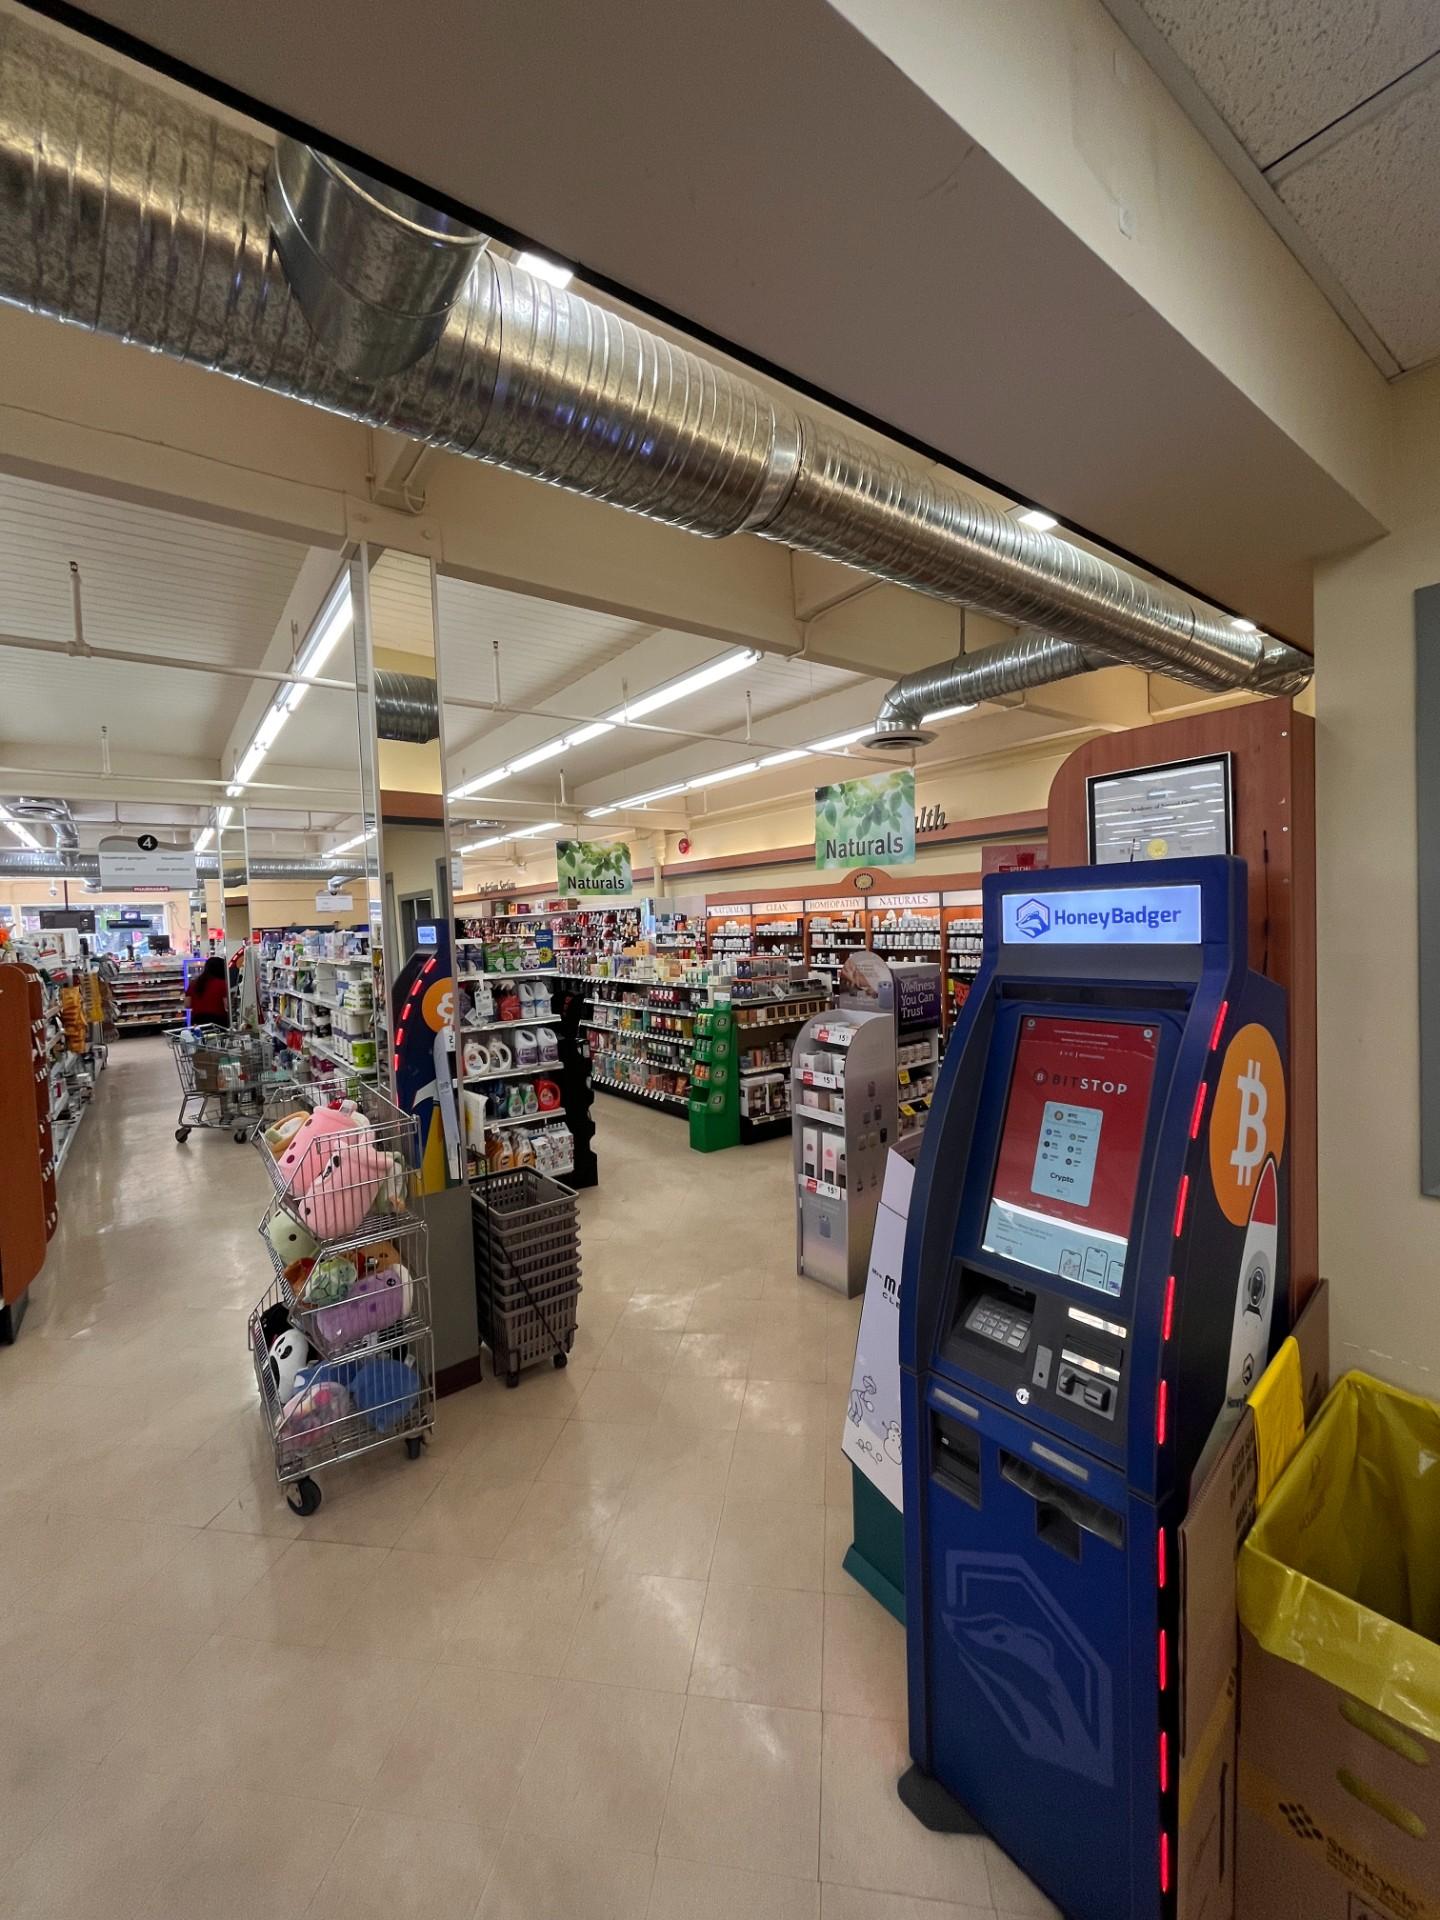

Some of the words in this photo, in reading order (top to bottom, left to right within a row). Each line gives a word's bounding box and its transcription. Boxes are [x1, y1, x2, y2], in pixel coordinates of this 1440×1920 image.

[142, 836, 153, 849] 4
[825, 831, 903, 860] Naturals
[567, 876, 625, 890] Naturals
[809, 899, 861, 910] HOMEOPATHY
[879, 894, 929, 906] NATURALS
[713, 905, 744, 914] NATURALS
[765, 903, 788, 912] CLEAN
[1054, 905, 1182, 930] HoneyBadger
[900, 979, 936, 994] Wellness
[901, 994, 917, 1006] You
[918, 992, 934, 1004] Can
[901, 1005, 923, 1018] Trust
[1052, 1073, 1128, 1095] BITSTOP
[1049, 1172, 1074, 1184] Crypto
